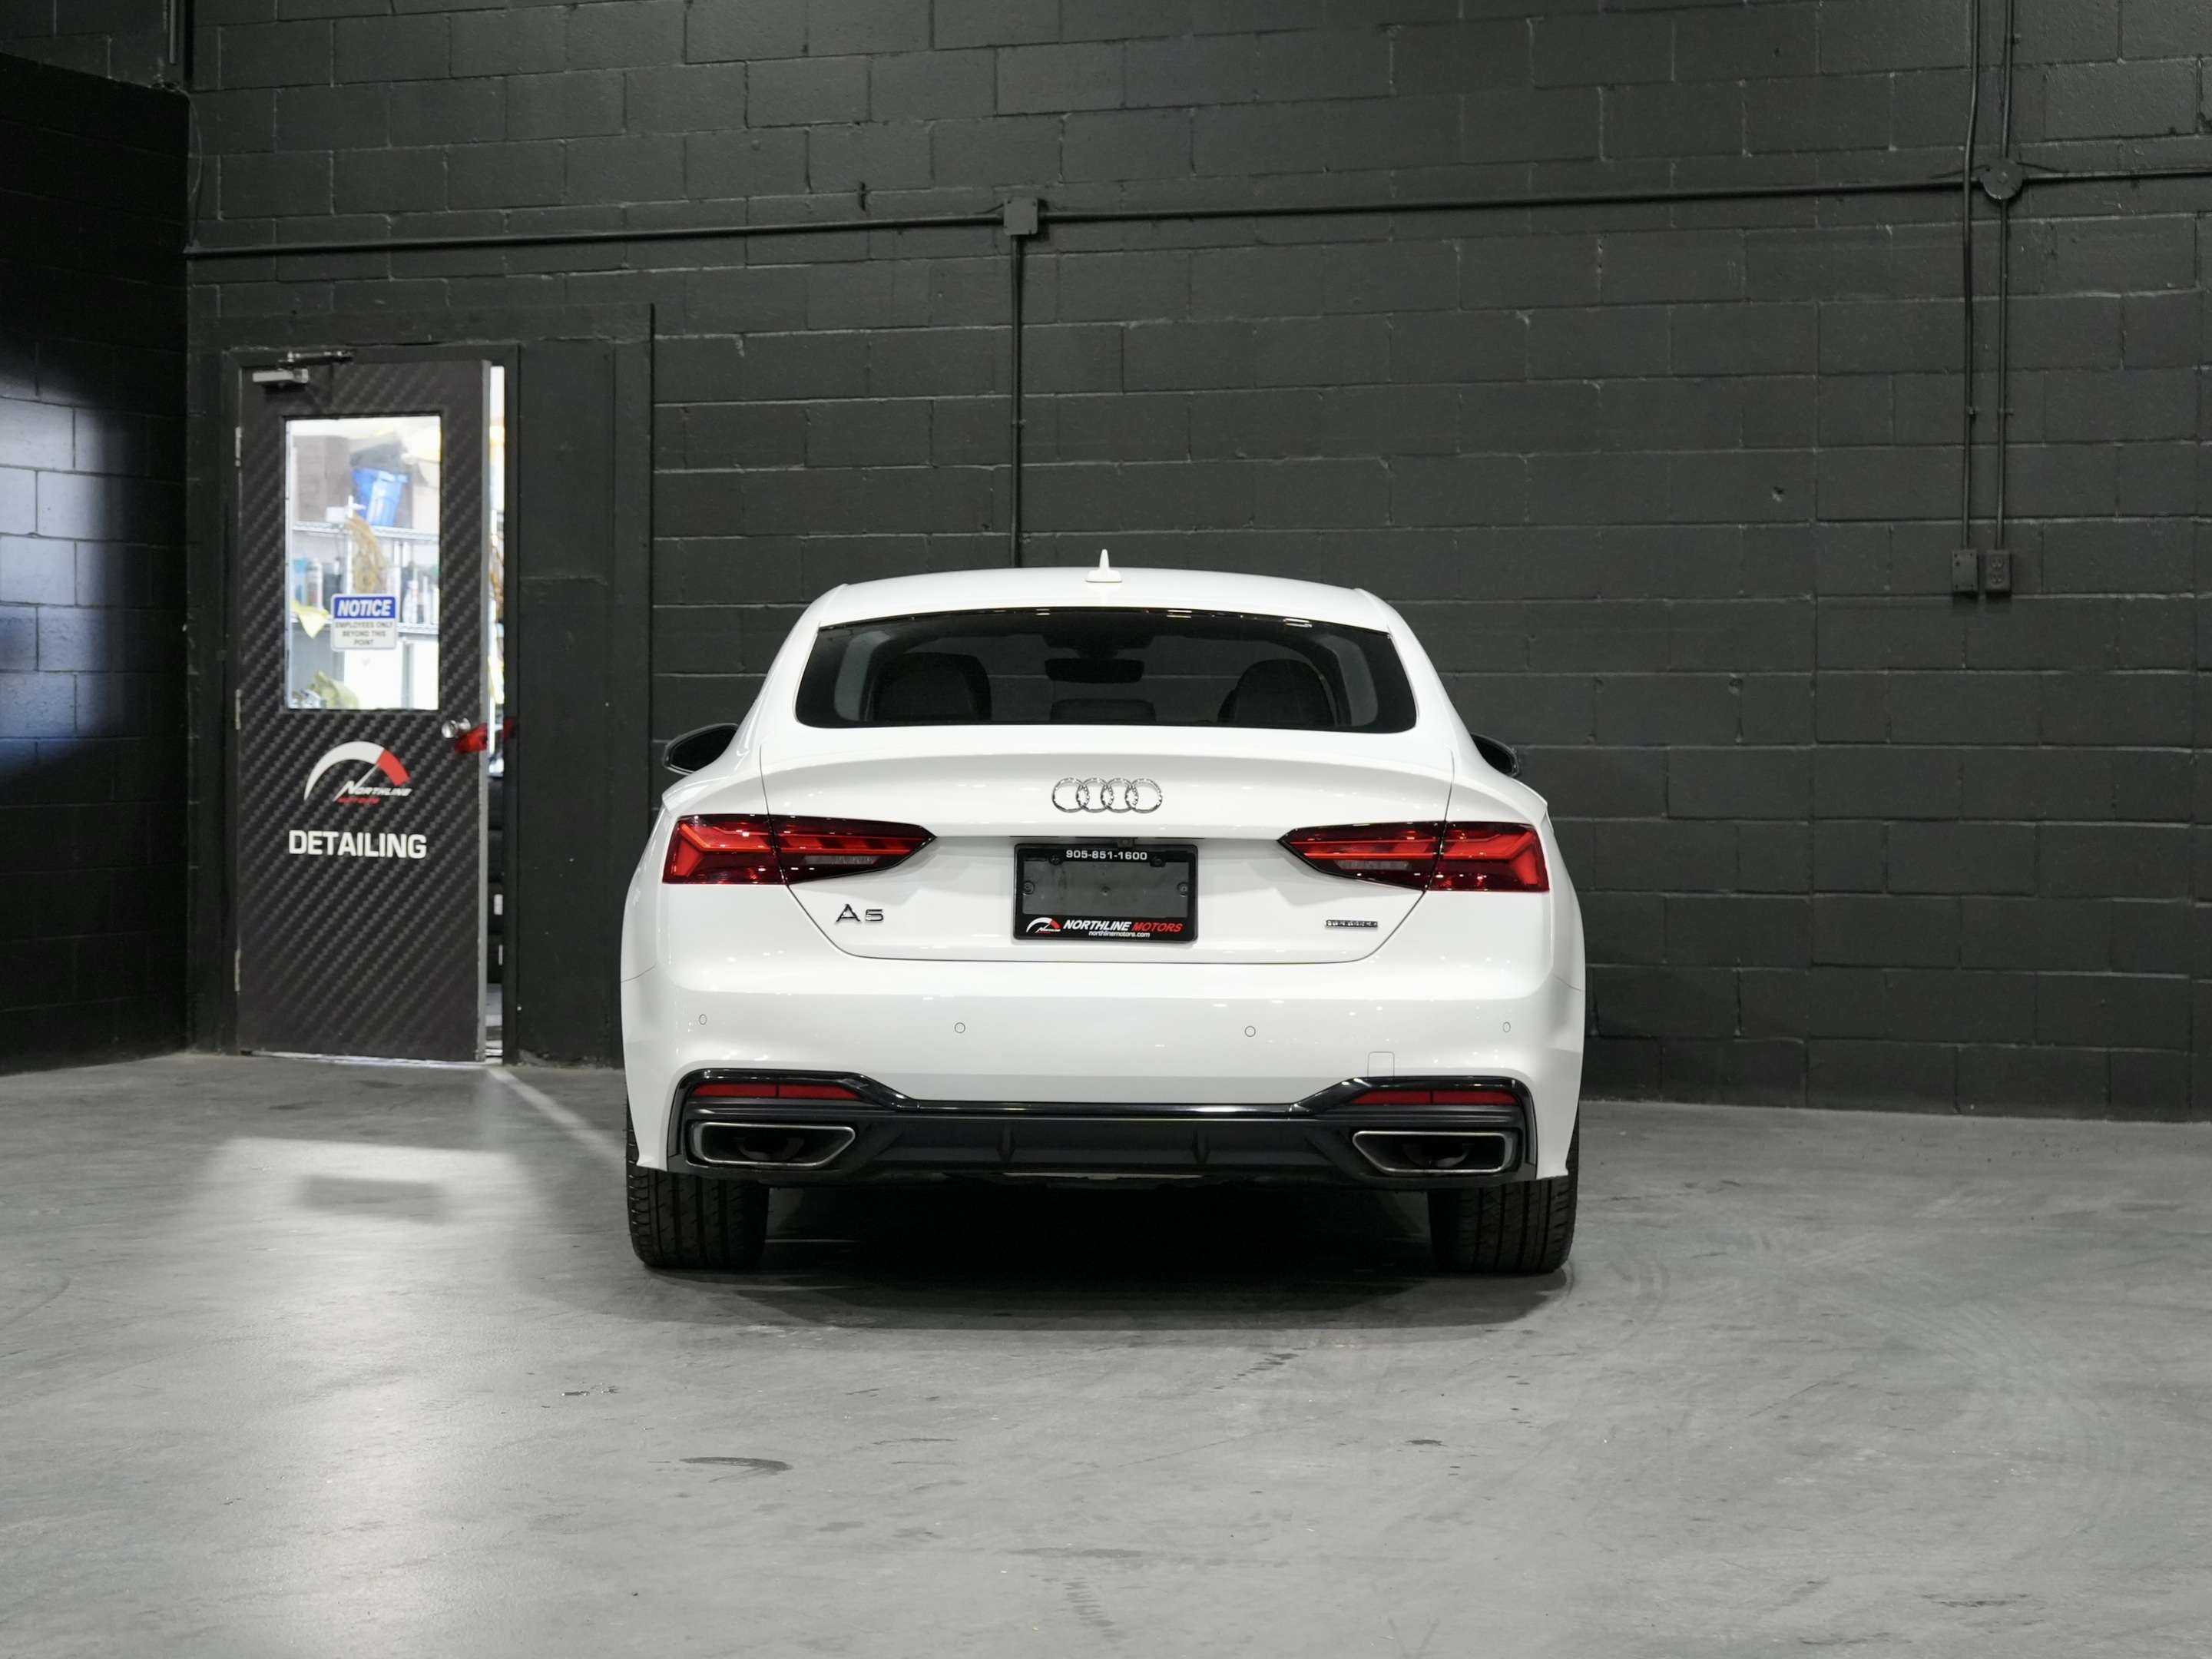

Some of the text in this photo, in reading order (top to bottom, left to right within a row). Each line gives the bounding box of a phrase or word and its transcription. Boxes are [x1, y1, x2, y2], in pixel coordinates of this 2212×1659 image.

[336, 598, 392, 617] NOTICE
[289, 830, 427, 859] DETAILING
[1065, 849, 1147, 860] 905-851-1600
[836, 903, 884, 922] A5
[1063, 919, 1132, 931] NORTHLINE
[1131, 922, 1184, 932] MOTORS
